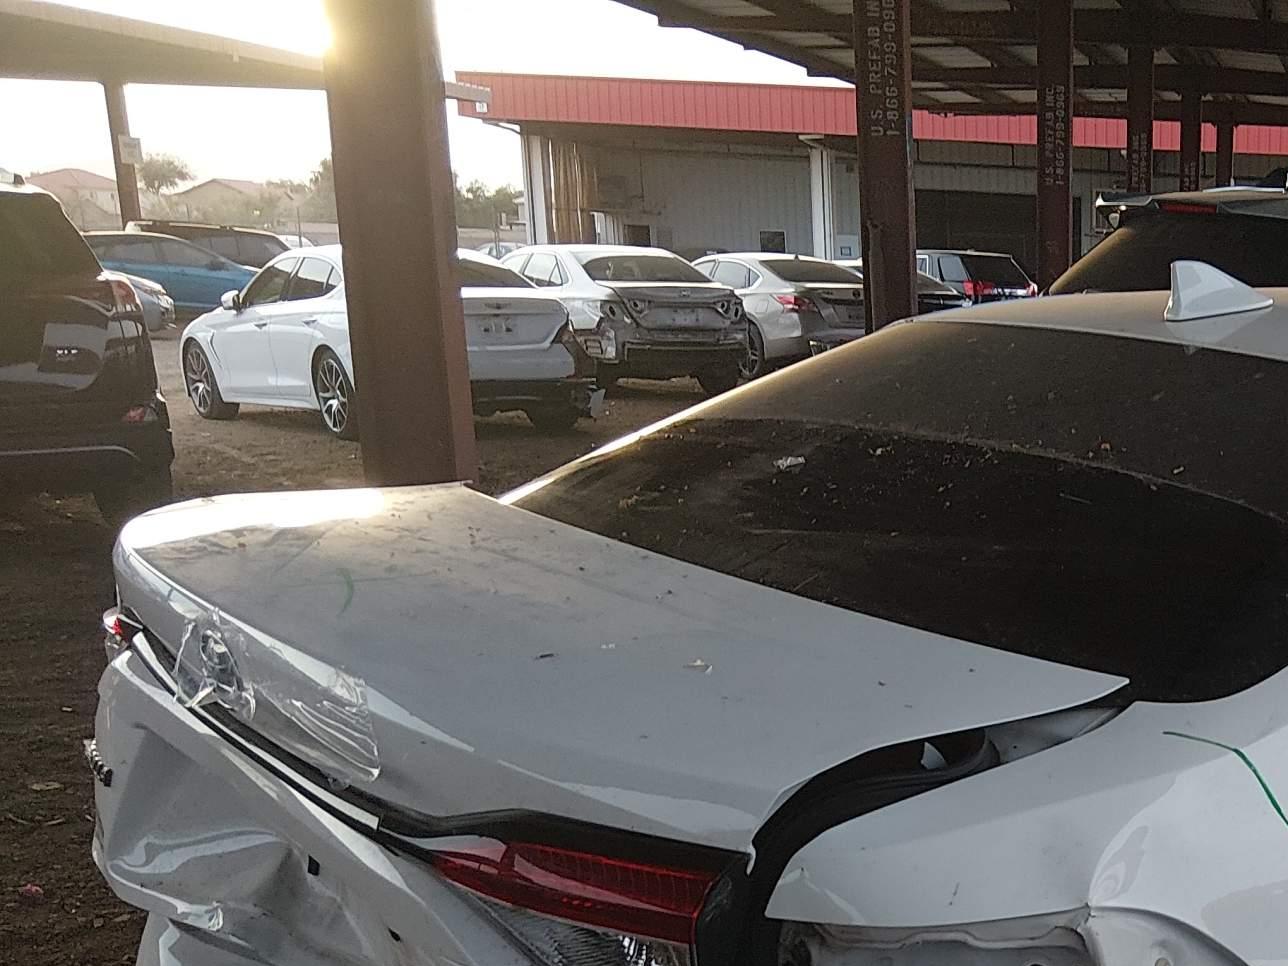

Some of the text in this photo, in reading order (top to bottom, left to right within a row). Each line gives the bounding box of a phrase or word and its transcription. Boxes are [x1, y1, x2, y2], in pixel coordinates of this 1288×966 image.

[867, 25, 882, 94] PREFAB
[871, 105, 884, 136] U.S.
[1044, 111, 1055, 158] PREFAB
